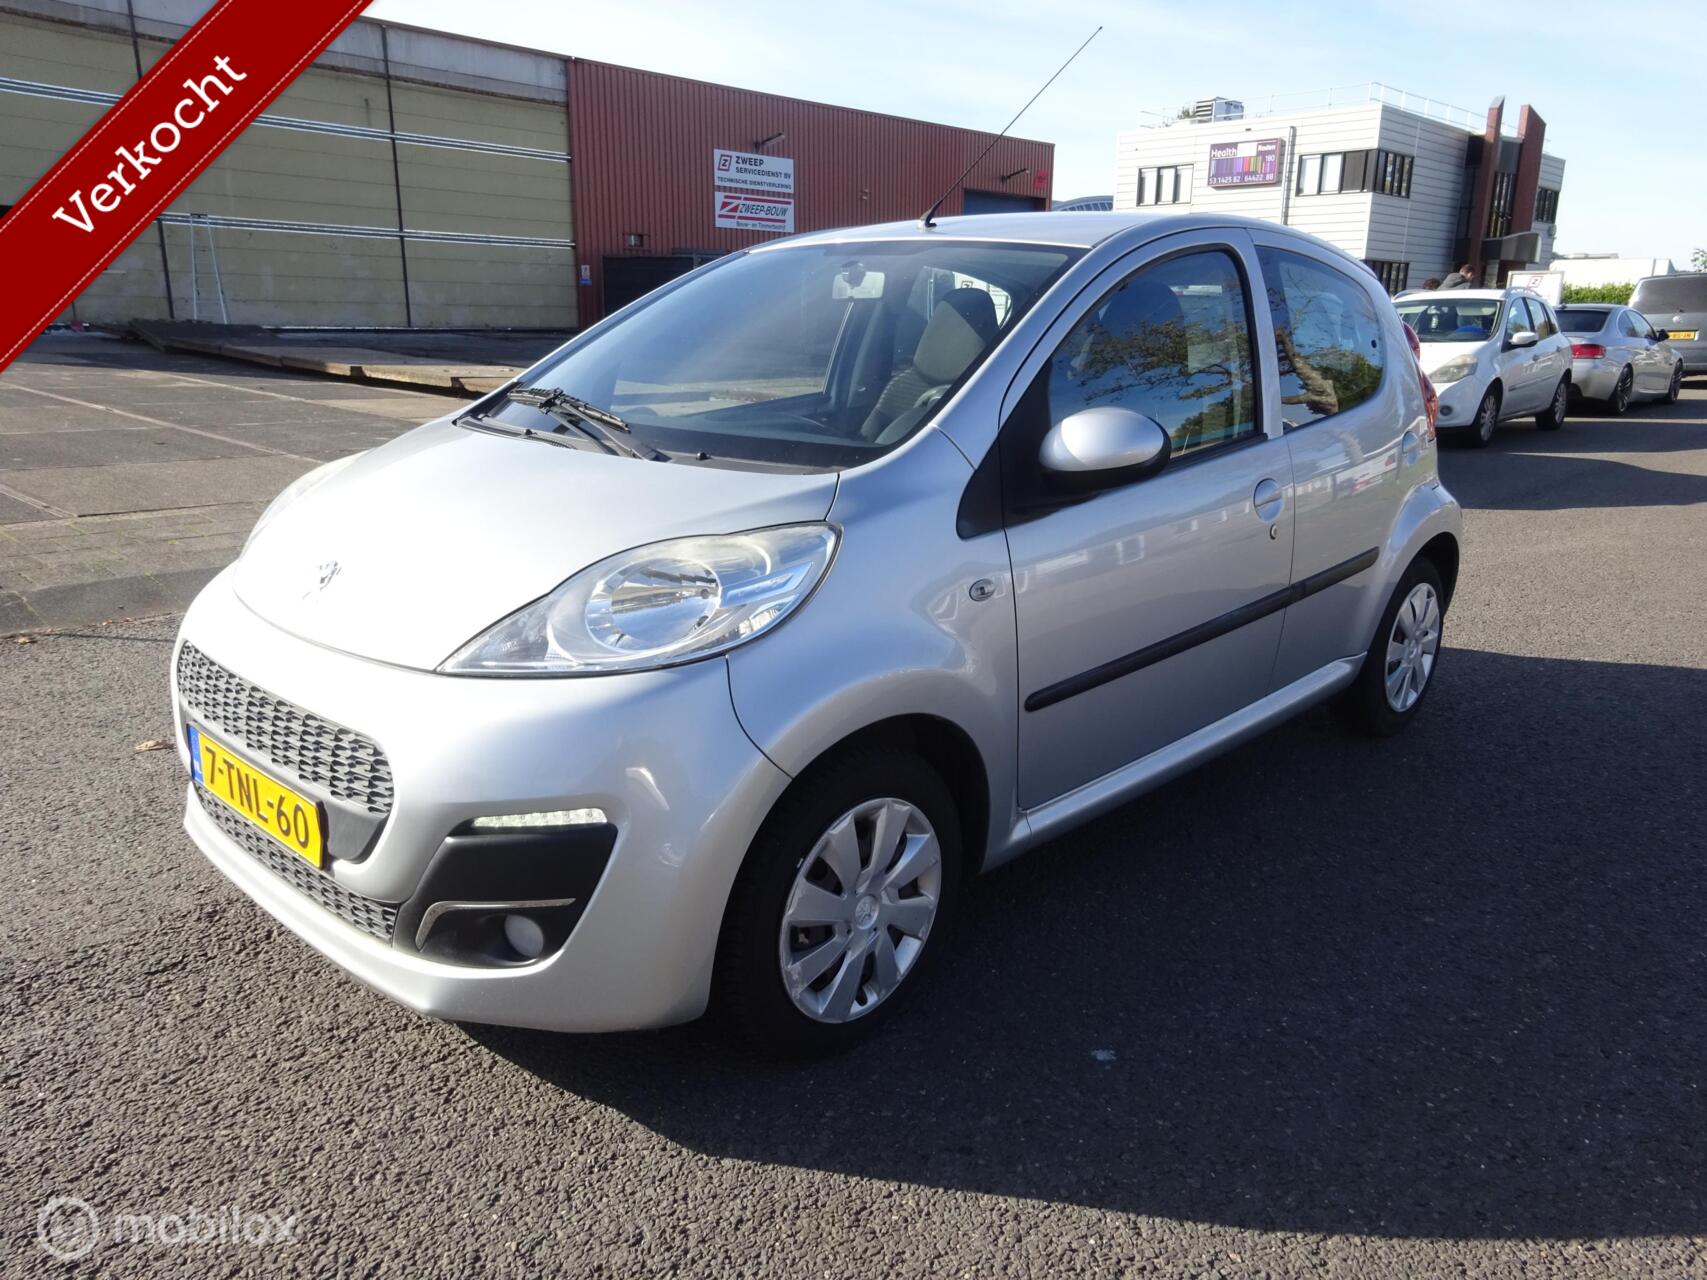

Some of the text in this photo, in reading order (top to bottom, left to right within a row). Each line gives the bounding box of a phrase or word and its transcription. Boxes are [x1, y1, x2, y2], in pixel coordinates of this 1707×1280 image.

[1211, 147, 1236, 158] Health
[735, 156, 764, 167] ZWEEP
[735, 167, 783, 178] SERVICEDIENST
[739, 203, 789, 217] ZWEEP-BOUW
[205, 746, 310, 849] 7-TNL-60
